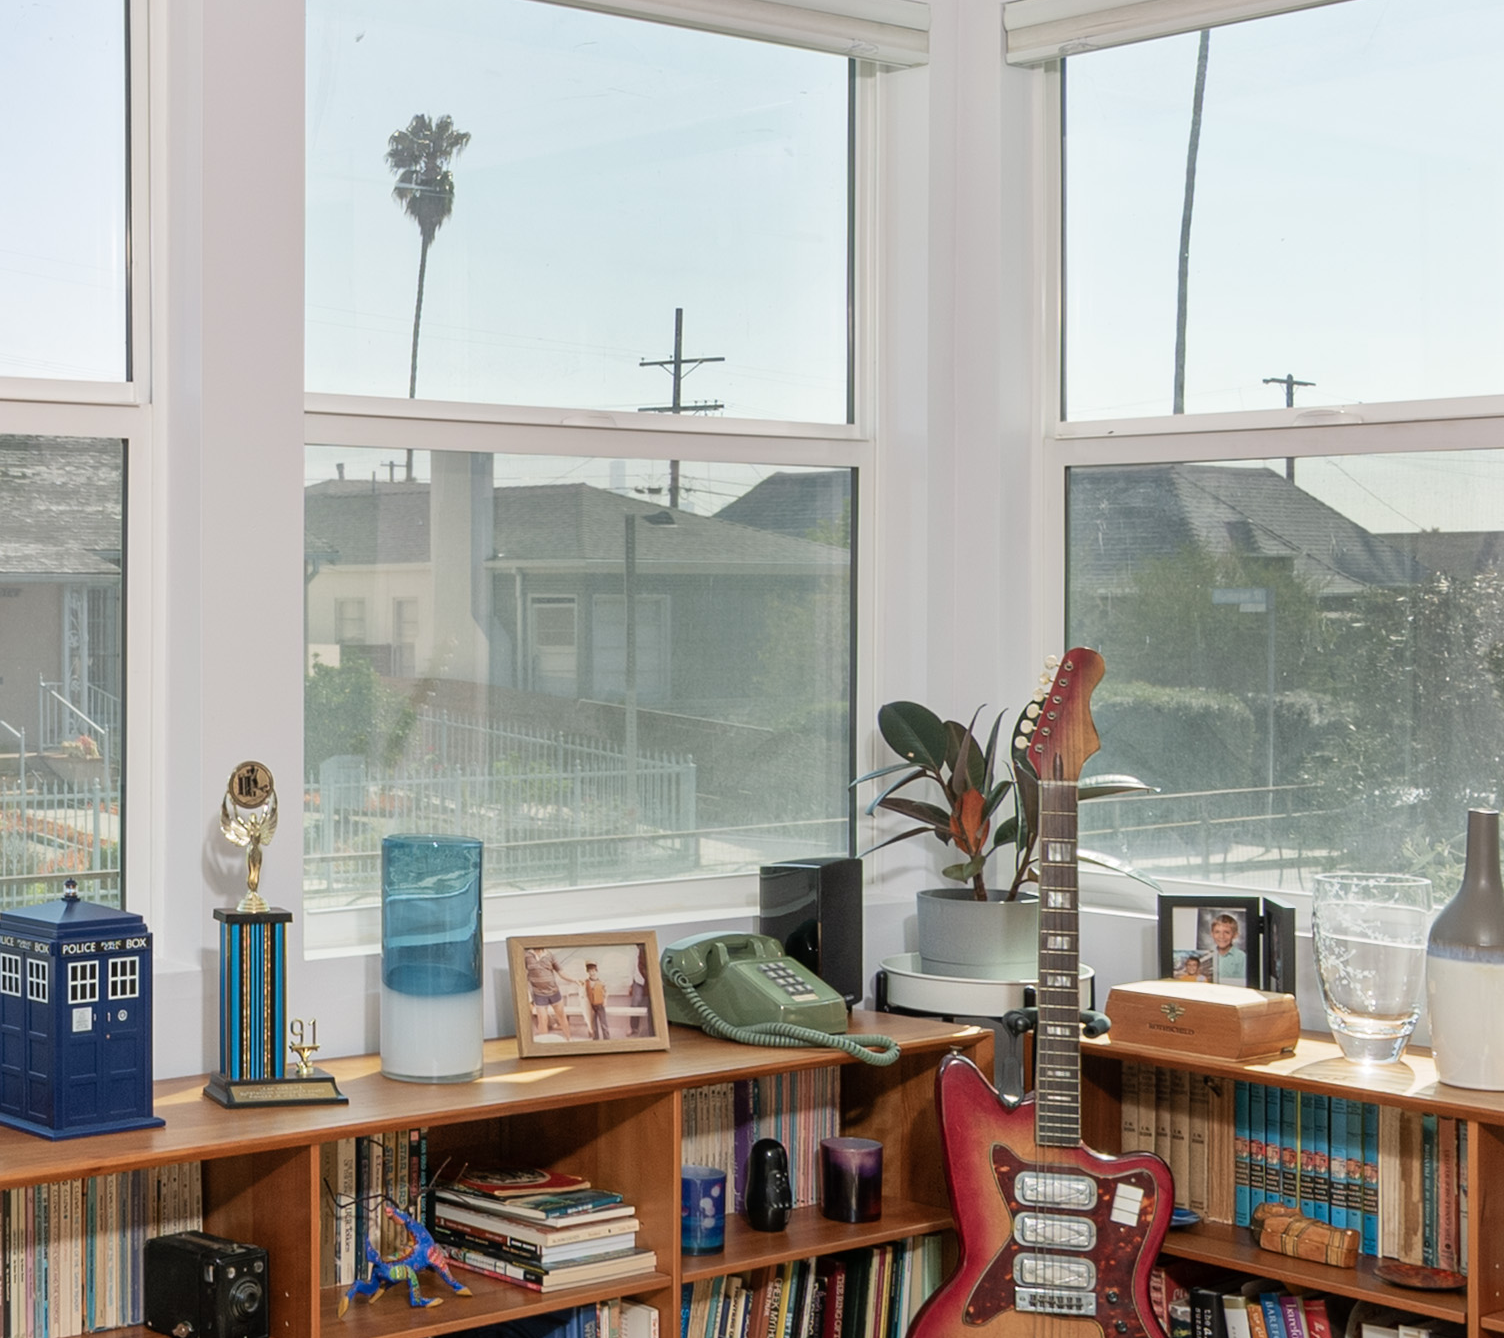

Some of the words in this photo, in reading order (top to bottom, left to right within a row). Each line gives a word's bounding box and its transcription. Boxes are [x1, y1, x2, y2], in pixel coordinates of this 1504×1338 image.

[34, 941, 51, 955] BOX
[61, 940, 96, 956] POLICE
[126, 936, 148, 950] BOX
[289, 1018, 317, 1047] 91
[384, 1146, 394, 1174] STAR
[399, 1142, 407, 1172] STAR
[399, 1175, 407, 1206] WARS
[344, 1225, 352, 1253] Tolkien
[770, 1278, 783, 1310] GREEK
[835, 1289, 844, 1319] RING
[1203, 1309, 1212, 1326] the
